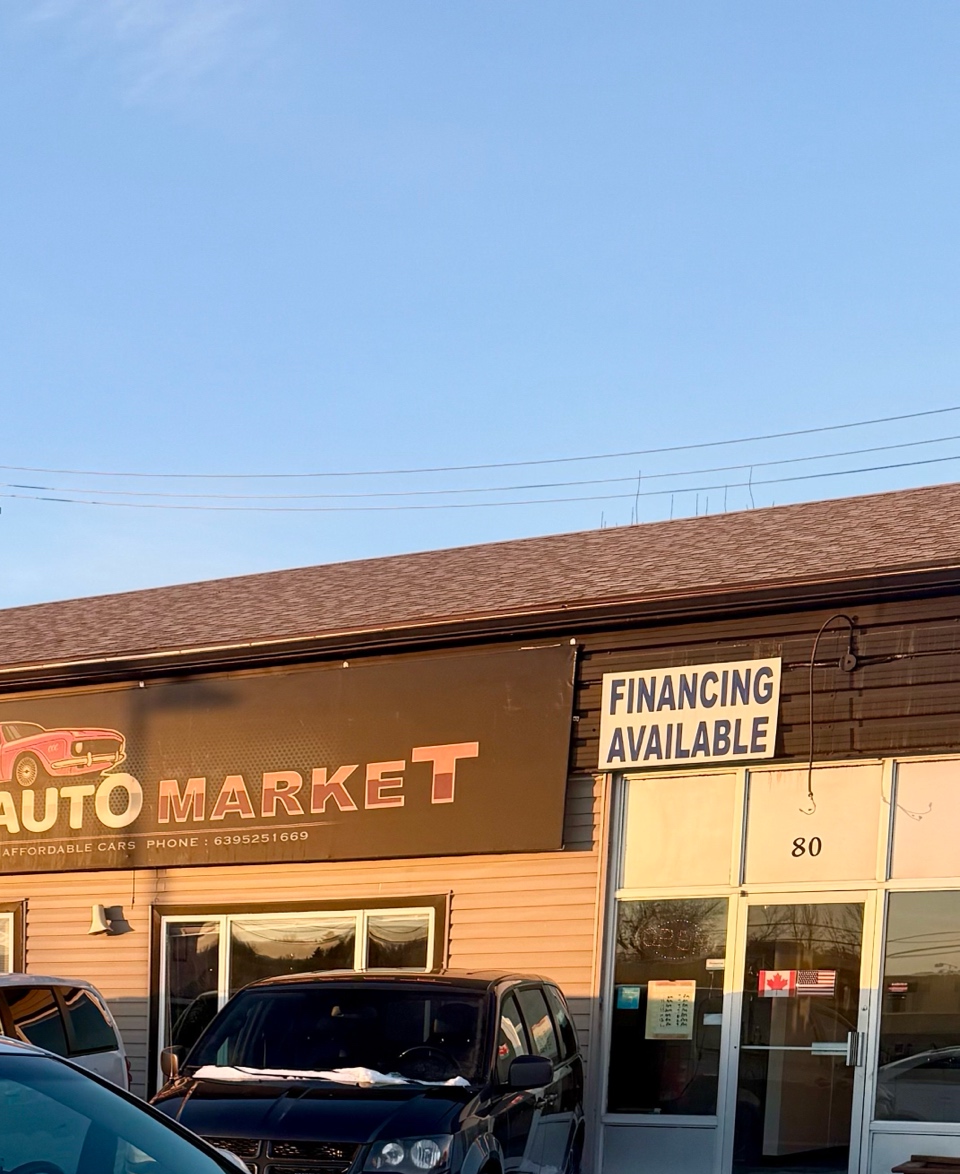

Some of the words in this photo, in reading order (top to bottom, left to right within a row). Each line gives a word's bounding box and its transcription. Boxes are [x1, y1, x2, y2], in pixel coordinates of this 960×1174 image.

[610, 667, 773, 715] FINANCING
[607, 717, 769, 763] AVAILABLE
[158, 741, 479, 823] MARKET
[2, 843, 92, 857] AFFORDABLE
[97, 841, 136, 852] CARS
[146, 837, 199, 849] PHONE
[213, 831, 309, 846] 6395251669
[791, 836, 822, 858] 80
